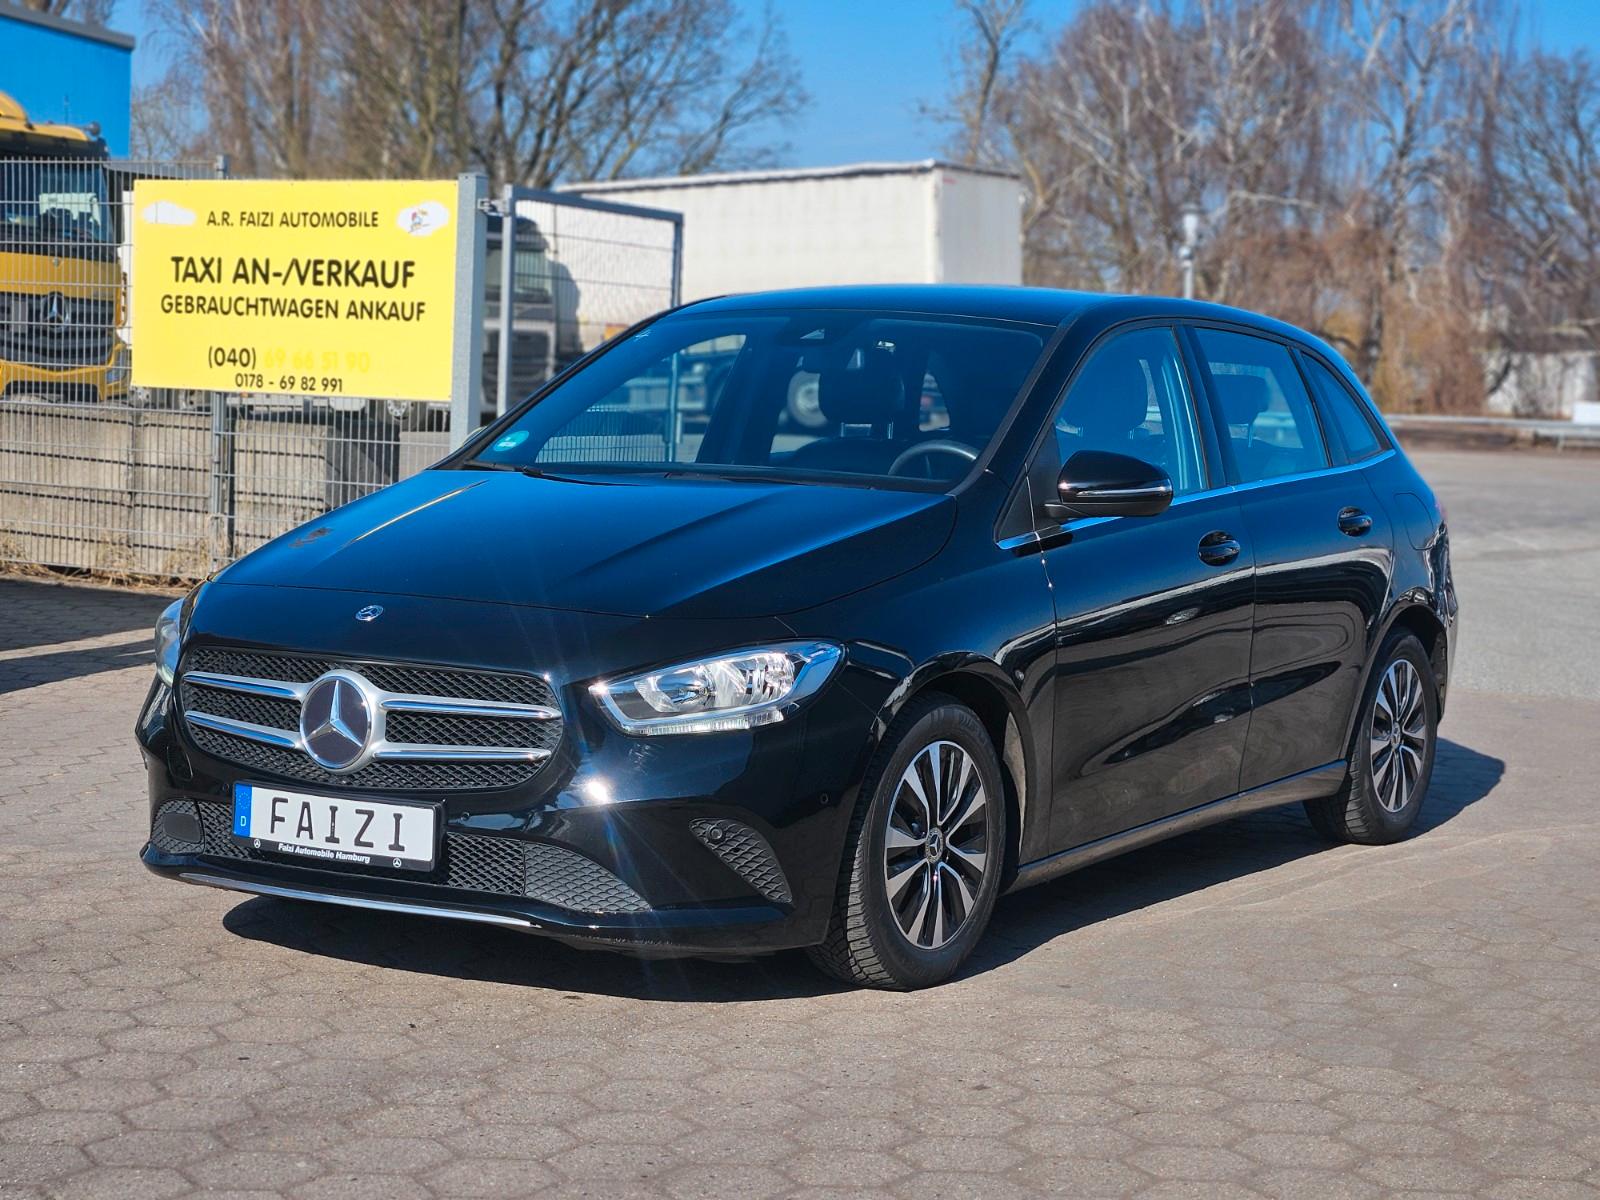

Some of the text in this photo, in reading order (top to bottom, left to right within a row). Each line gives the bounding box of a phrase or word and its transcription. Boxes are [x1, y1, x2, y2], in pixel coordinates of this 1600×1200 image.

[206, 211, 379, 228] A.R. FAIZI AUTOMOBILE
[171, 256, 222, 283] TAXI
[161, 294, 426, 321] GEBRAUCHTWAGEN ANKAUF
[208, 346, 257, 370] (040)
[234, 373, 264, 389] 0178
[279, 375, 296, 390] 69
[300, 376, 316, 391] 82
[321, 377, 342, 393] 991
[240, 815, 247, 827] D
[270, 797, 406, 852] FAIZI
[278, 843, 371, 864] Faizi Automobile Hamburg
